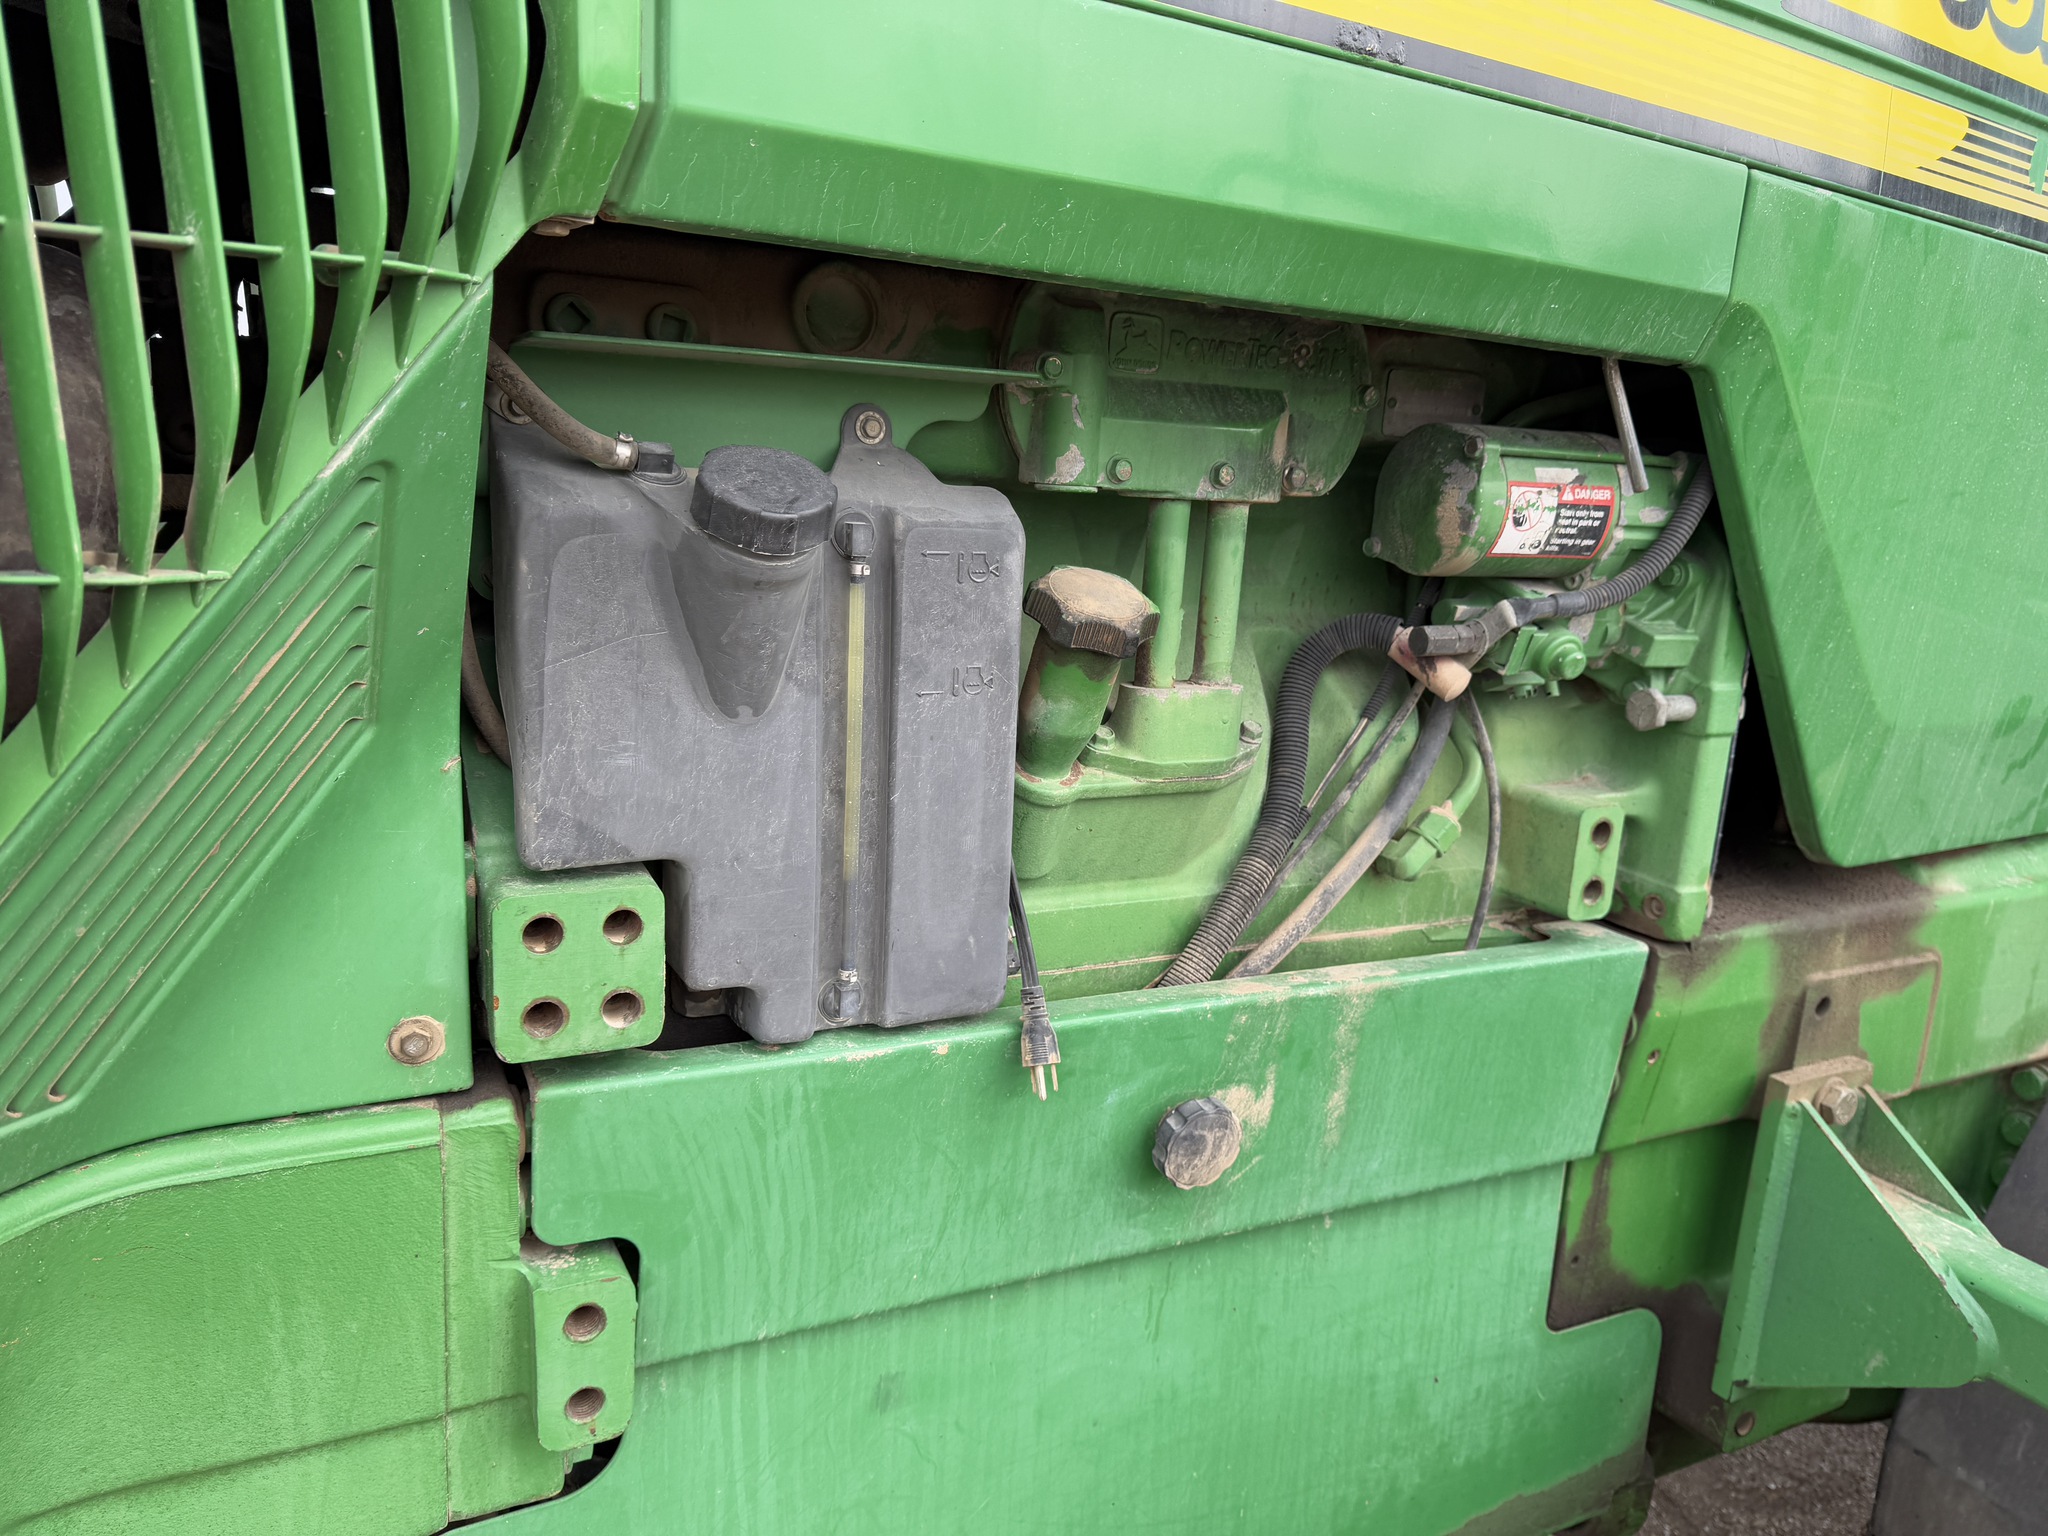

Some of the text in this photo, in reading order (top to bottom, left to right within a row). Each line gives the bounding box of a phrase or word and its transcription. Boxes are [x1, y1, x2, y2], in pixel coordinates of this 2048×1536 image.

[1574, 488, 1611, 500] DANGER
[1560, 508, 1604, 519] Start only from
[1571, 518, 1579, 526] in
[1578, 518, 1593, 527] park
[1549, 538, 1575, 547] Starting
[1581, 539, 1596, 547] gear
